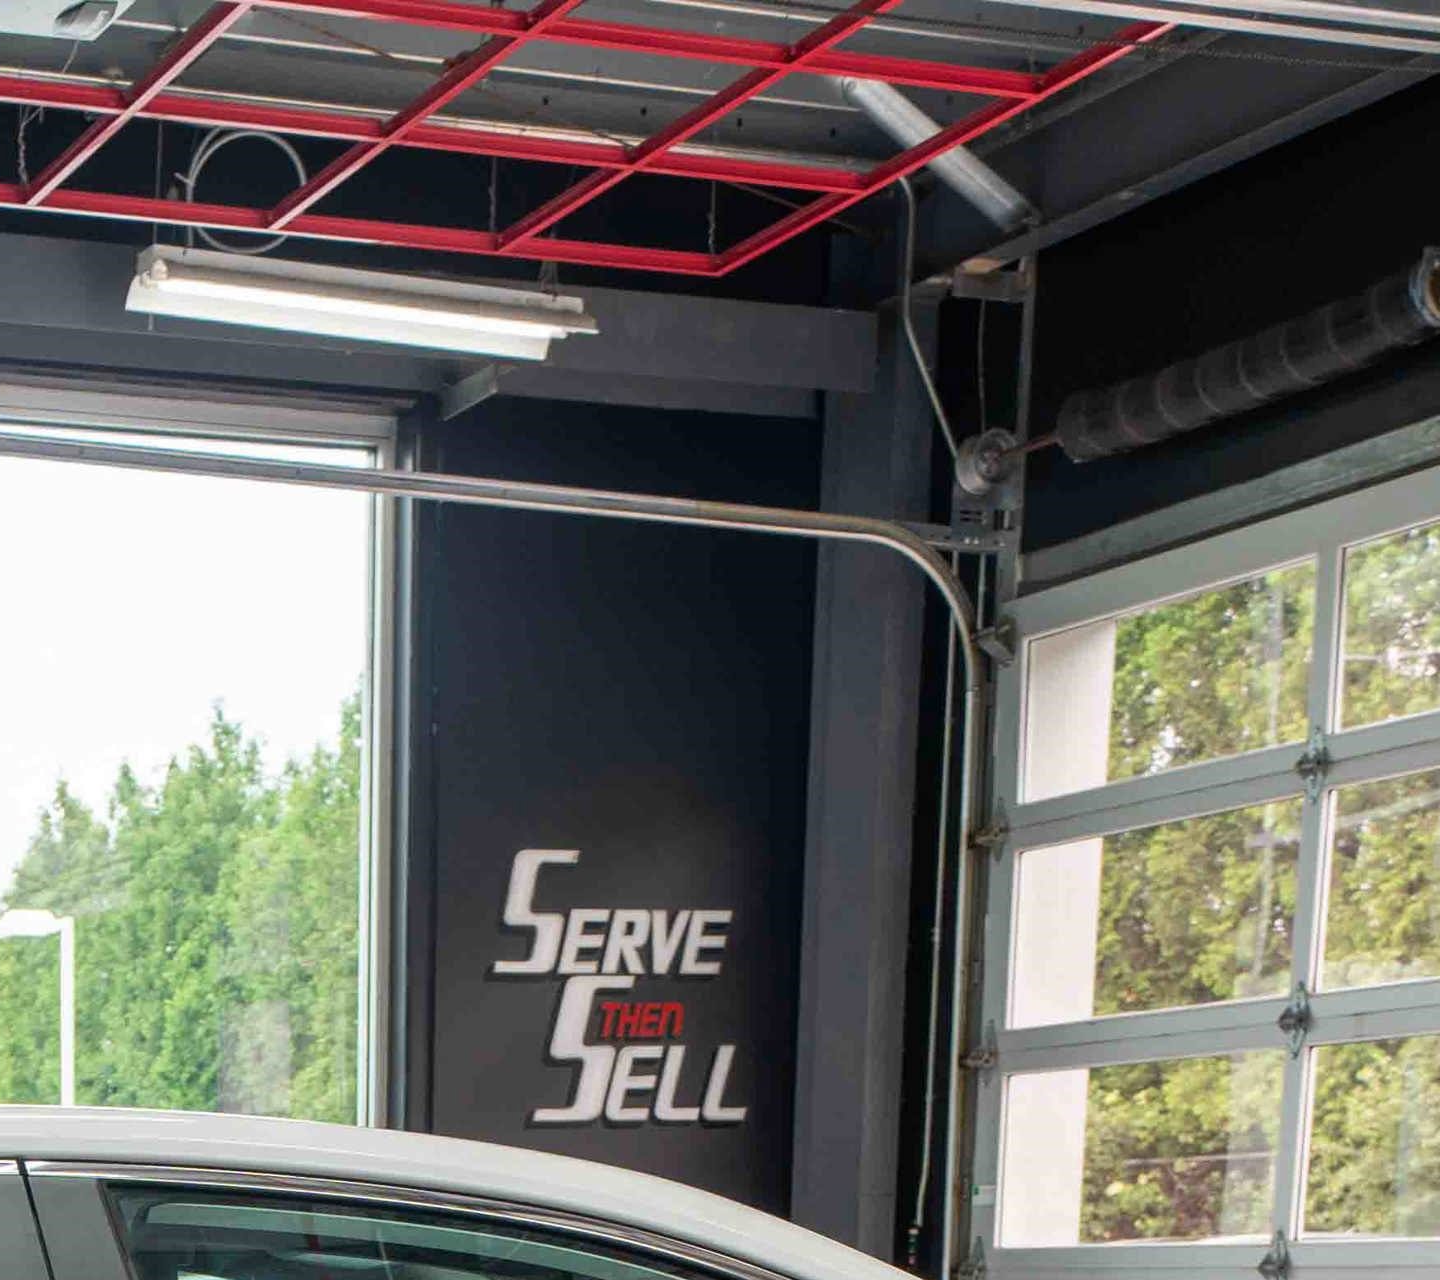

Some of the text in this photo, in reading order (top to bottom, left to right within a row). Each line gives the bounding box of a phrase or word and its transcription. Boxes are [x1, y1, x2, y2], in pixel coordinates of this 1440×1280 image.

[493, 849, 733, 975] SERVE
[532, 975, 748, 1122] SELL
[600, 1001, 685, 1039] THEN
